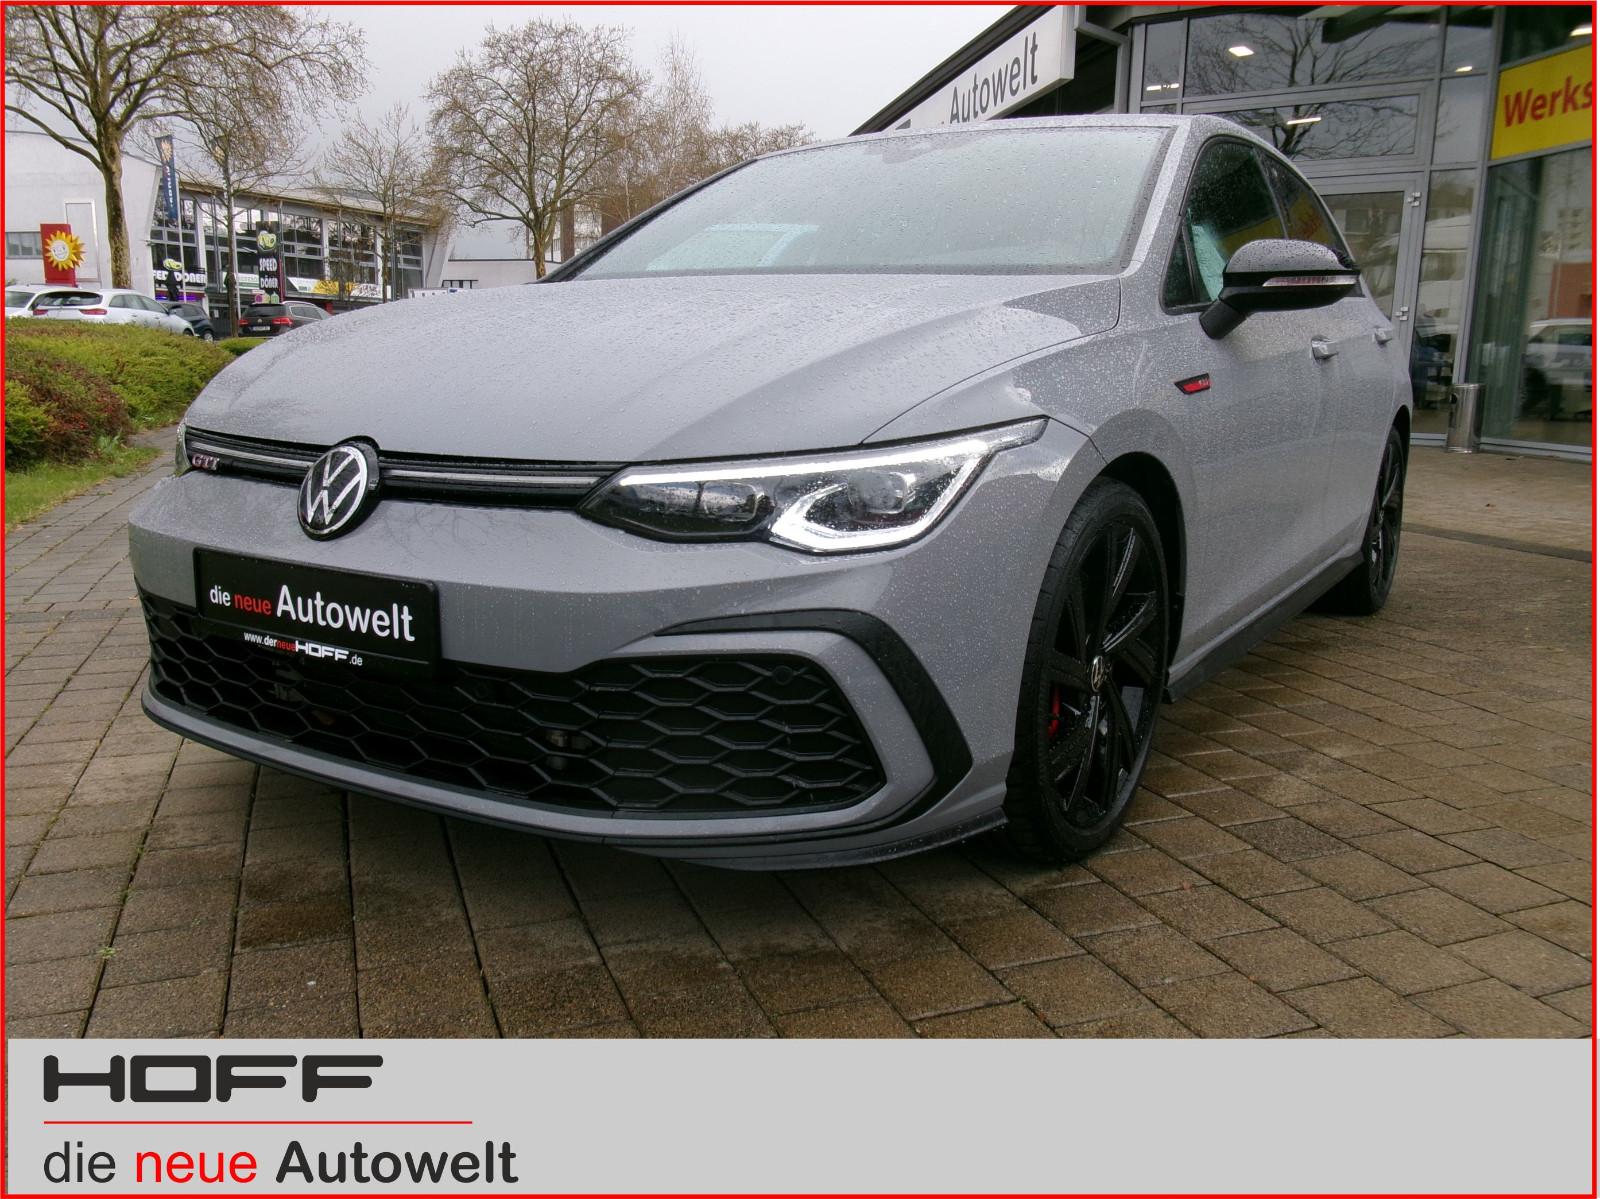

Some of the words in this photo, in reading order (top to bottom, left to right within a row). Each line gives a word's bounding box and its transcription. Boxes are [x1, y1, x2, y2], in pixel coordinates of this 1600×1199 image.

[950, 32, 1038, 125] Autowelt
[1503, 75, 1592, 128] Werks
[259, 258, 278, 272] SPEED
[192, 454, 220, 471] GTI
[209, 584, 232, 608] die
[234, 592, 272, 616] neue
[276, 584, 416, 642] Autowelt
